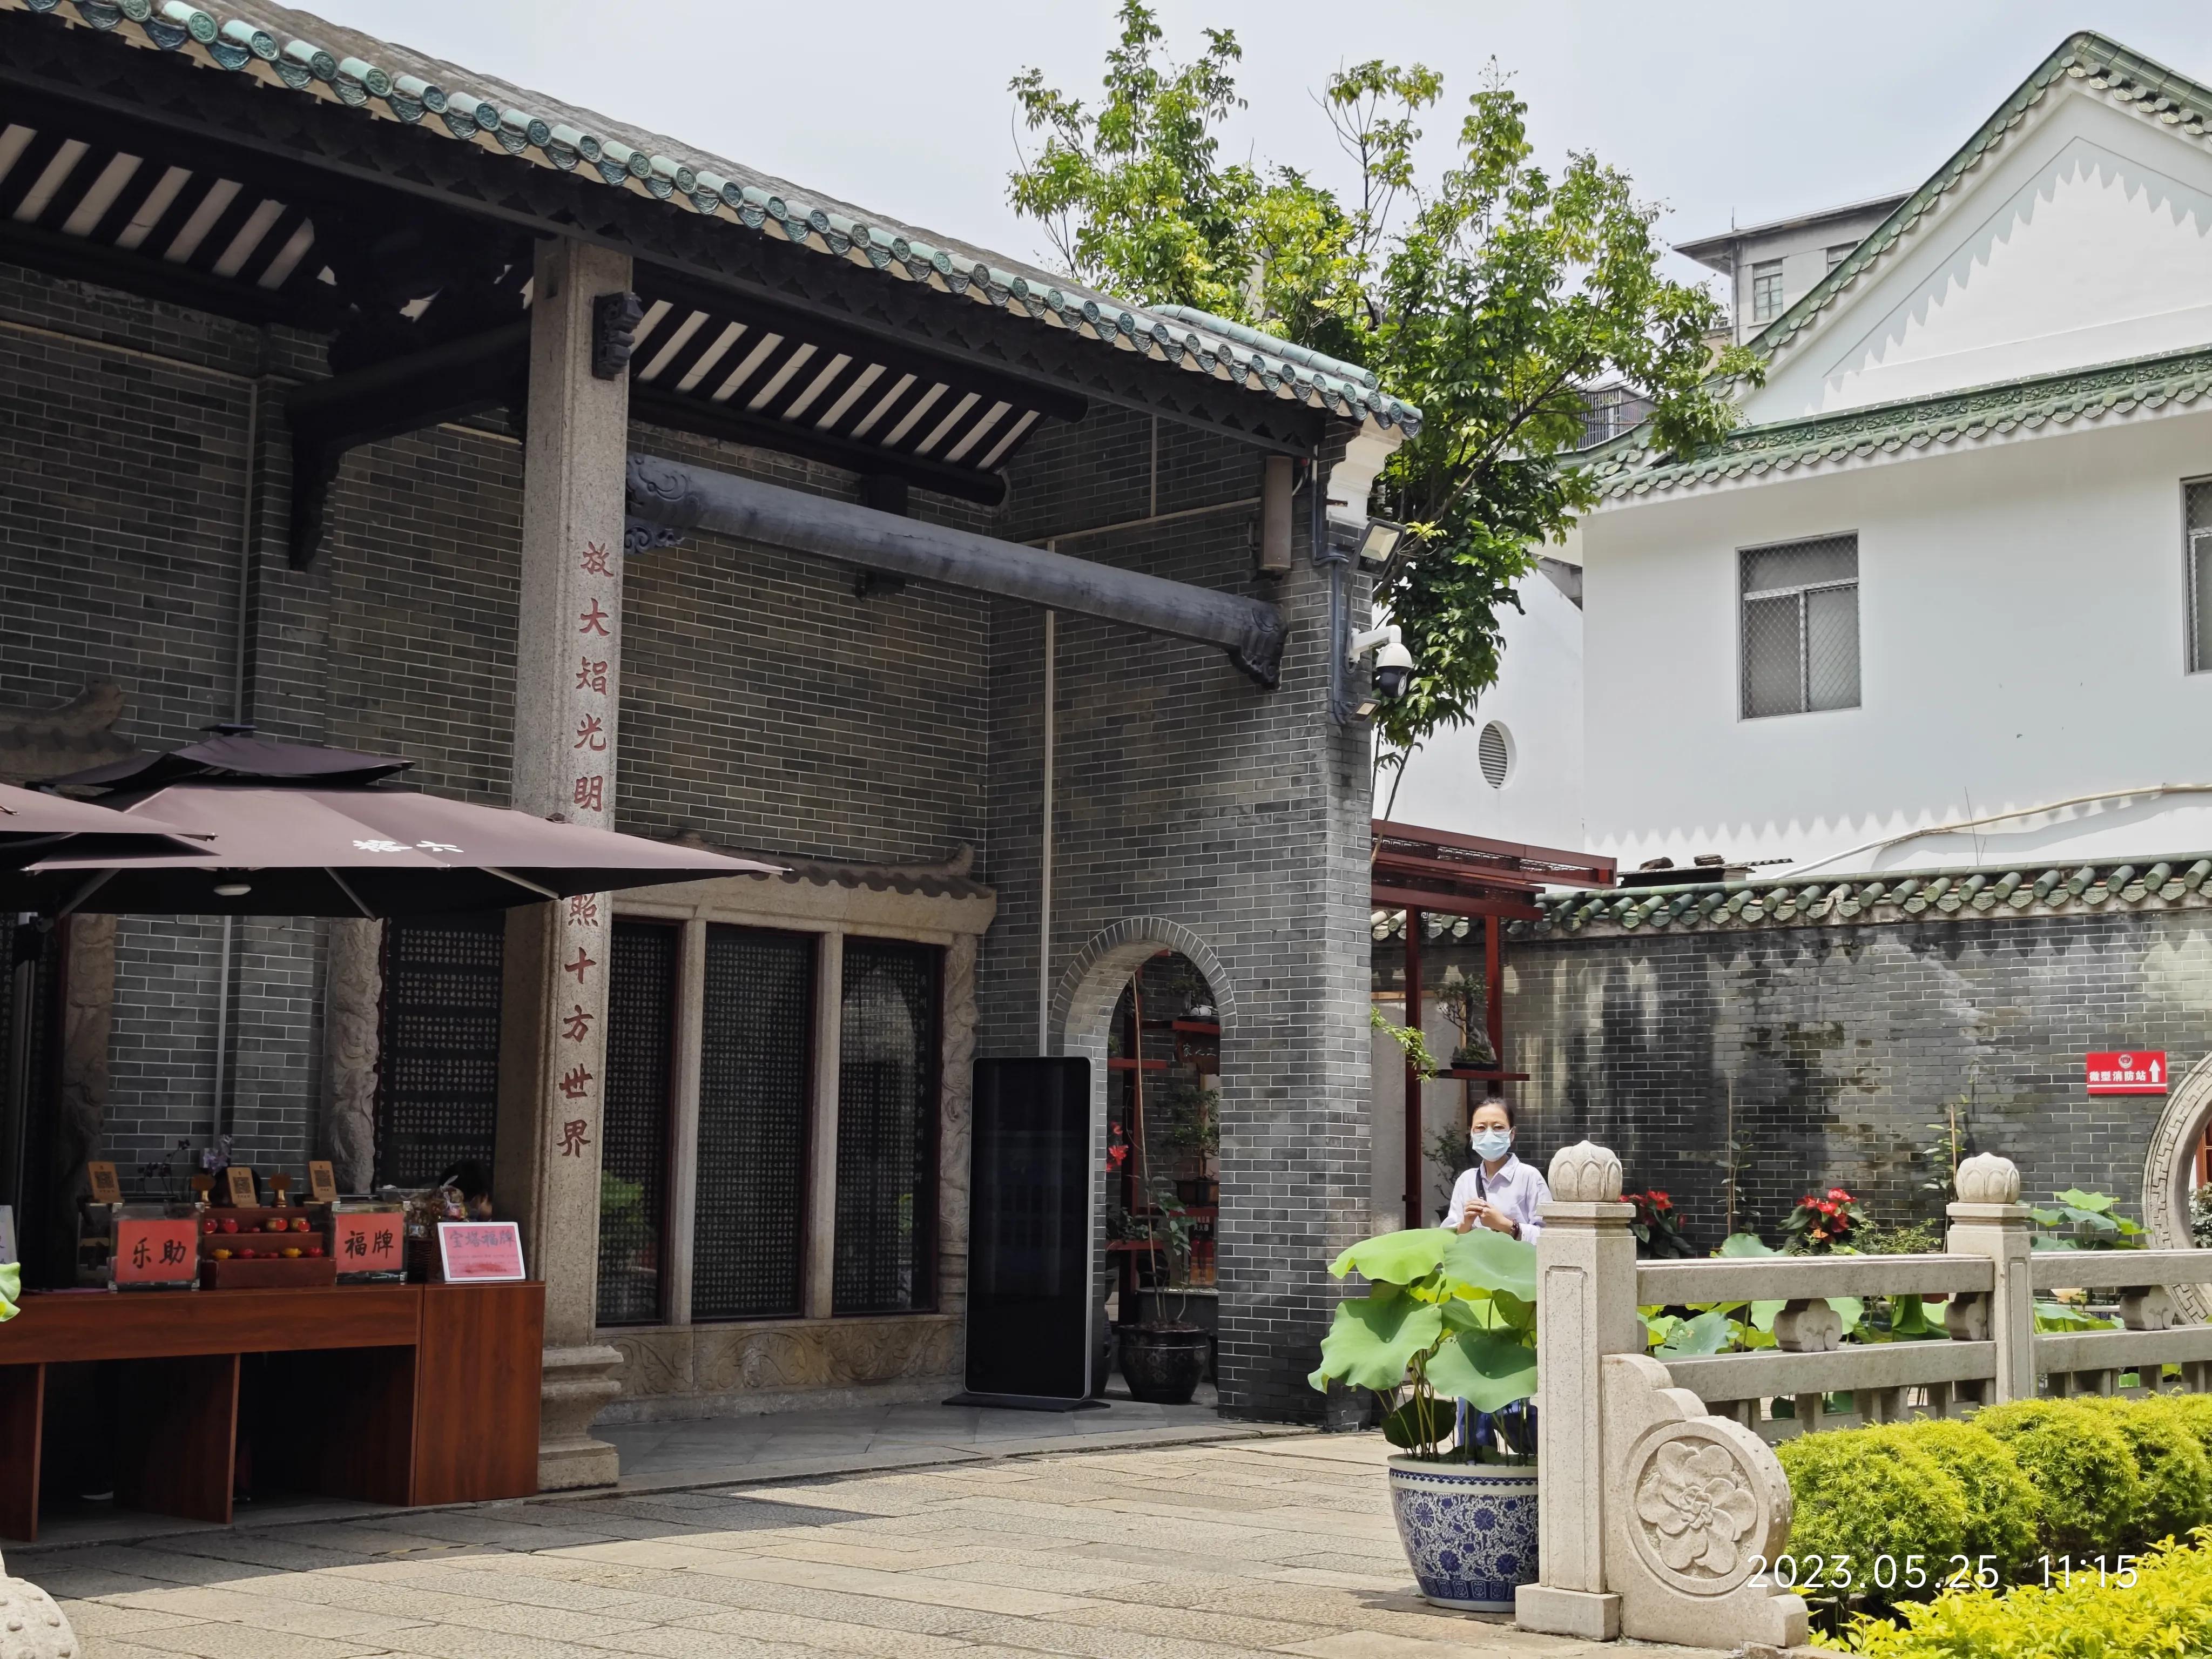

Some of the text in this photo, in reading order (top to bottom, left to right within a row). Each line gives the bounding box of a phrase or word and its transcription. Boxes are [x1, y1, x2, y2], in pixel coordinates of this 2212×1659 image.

[2089, 1070, 2147, 1082] 微型消防站
[132, 1237, 186, 1269] 乐助
[345, 1229, 394, 1259] 福牌
